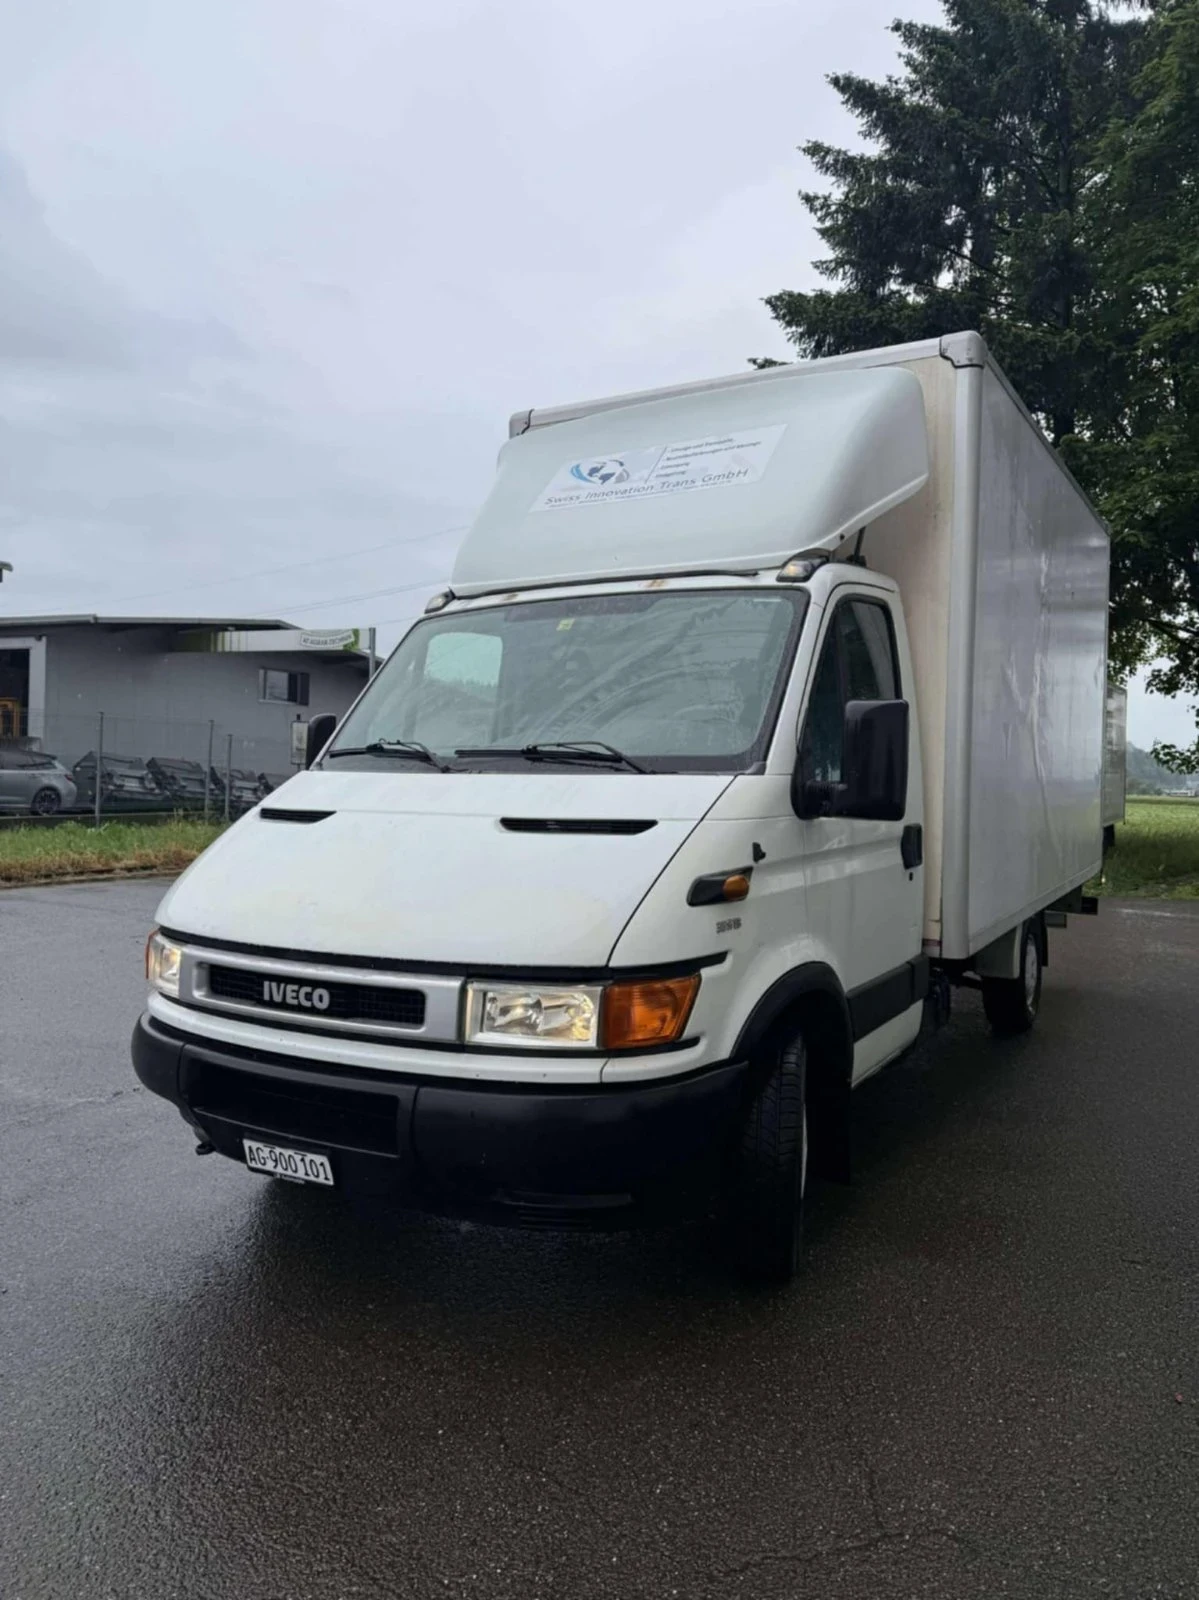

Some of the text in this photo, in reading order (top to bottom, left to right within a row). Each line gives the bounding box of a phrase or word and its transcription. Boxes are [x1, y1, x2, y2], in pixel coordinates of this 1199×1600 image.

[545, 493, 581, 505] Swiss
[585, 484, 654, 499] Innovation
[659, 477, 697, 490] Trans
[702, 468, 749, 482] GmbH
[263, 980, 330, 1010] IVECO
